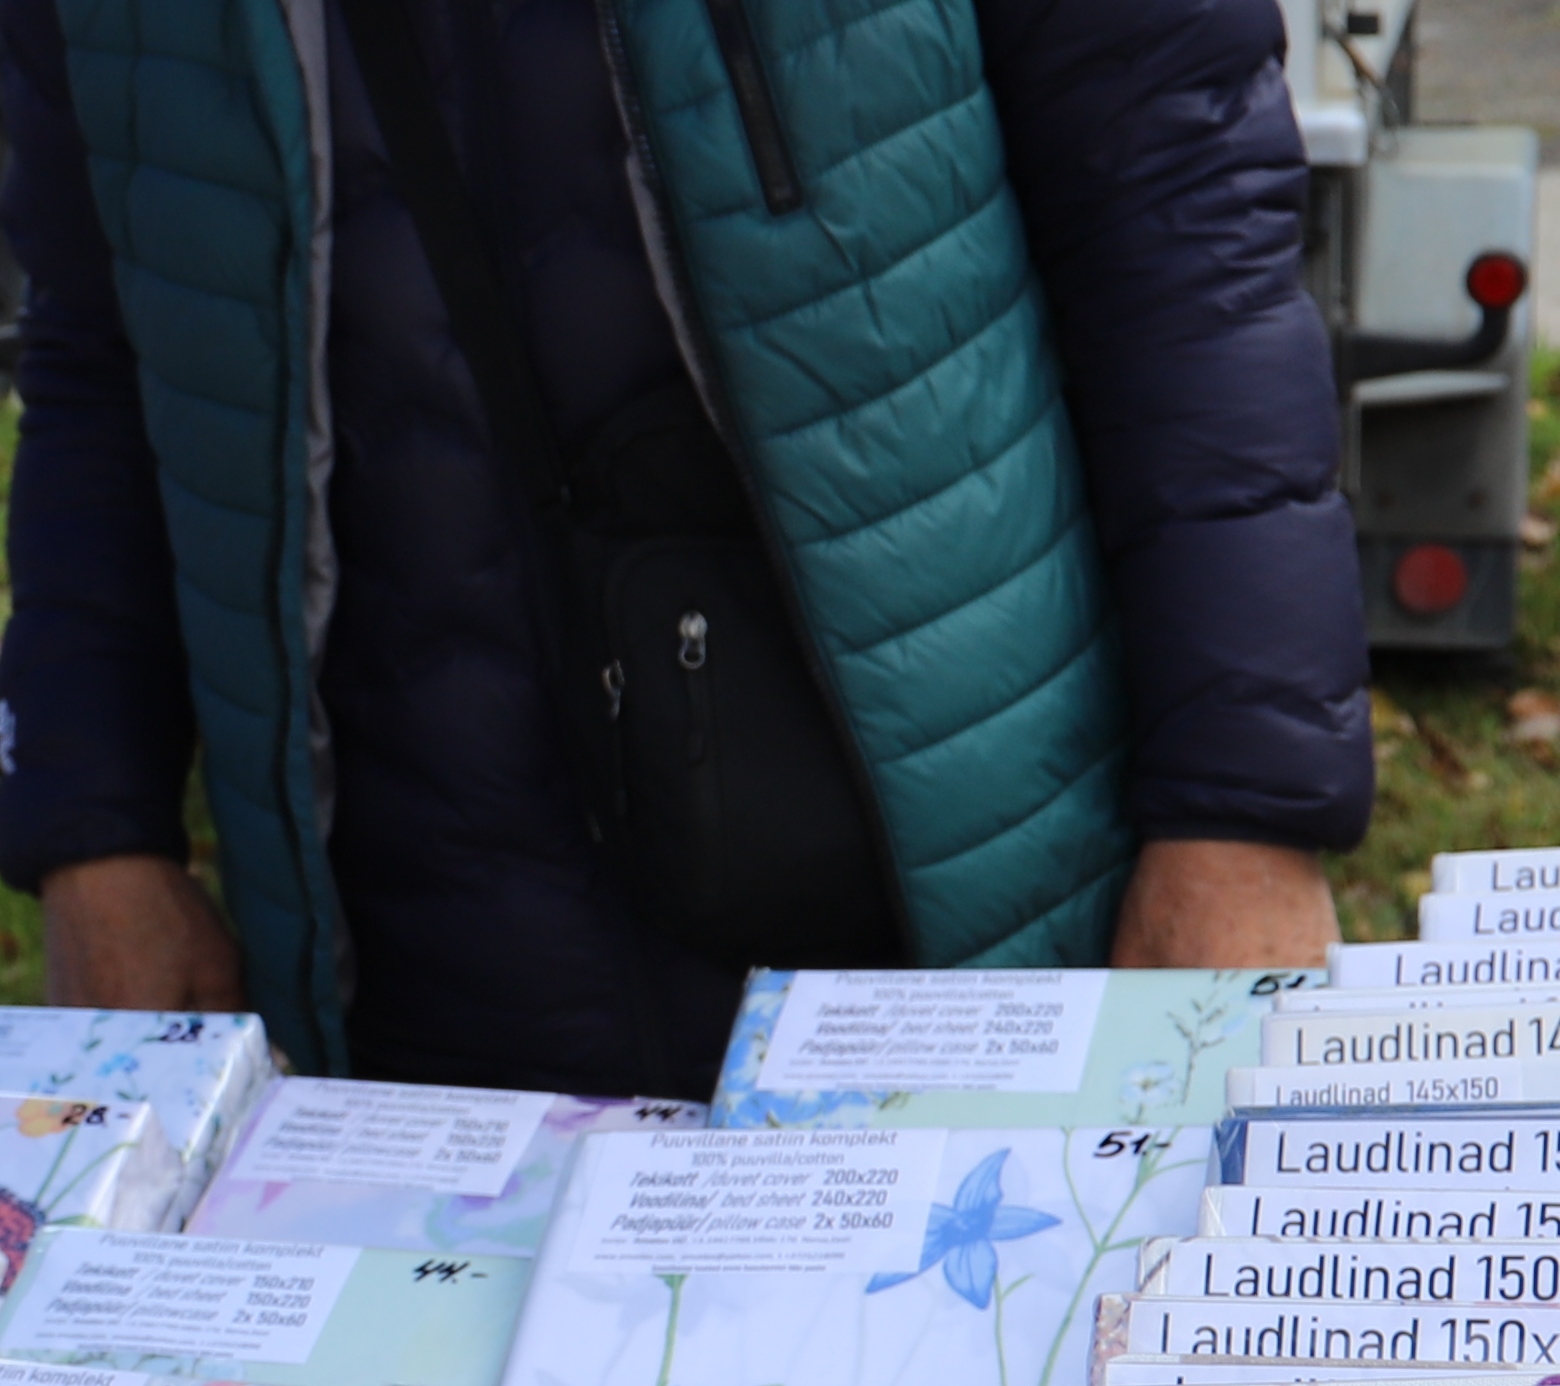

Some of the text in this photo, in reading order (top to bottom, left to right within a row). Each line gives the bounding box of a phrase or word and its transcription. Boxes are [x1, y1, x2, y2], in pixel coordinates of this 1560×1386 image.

[1296, 1018, 1517, 1066] Laudlinad
[1276, 1075, 1500, 1106] Laudlinad 145x150
[1276, 1129, 1522, 1175] Laudlinad
[1252, 1197, 1496, 1237] Laudlinad
[1204, 1254, 1457, 1299] Laudlinad
[1161, 1313, 1419, 1358] Laudlinad
